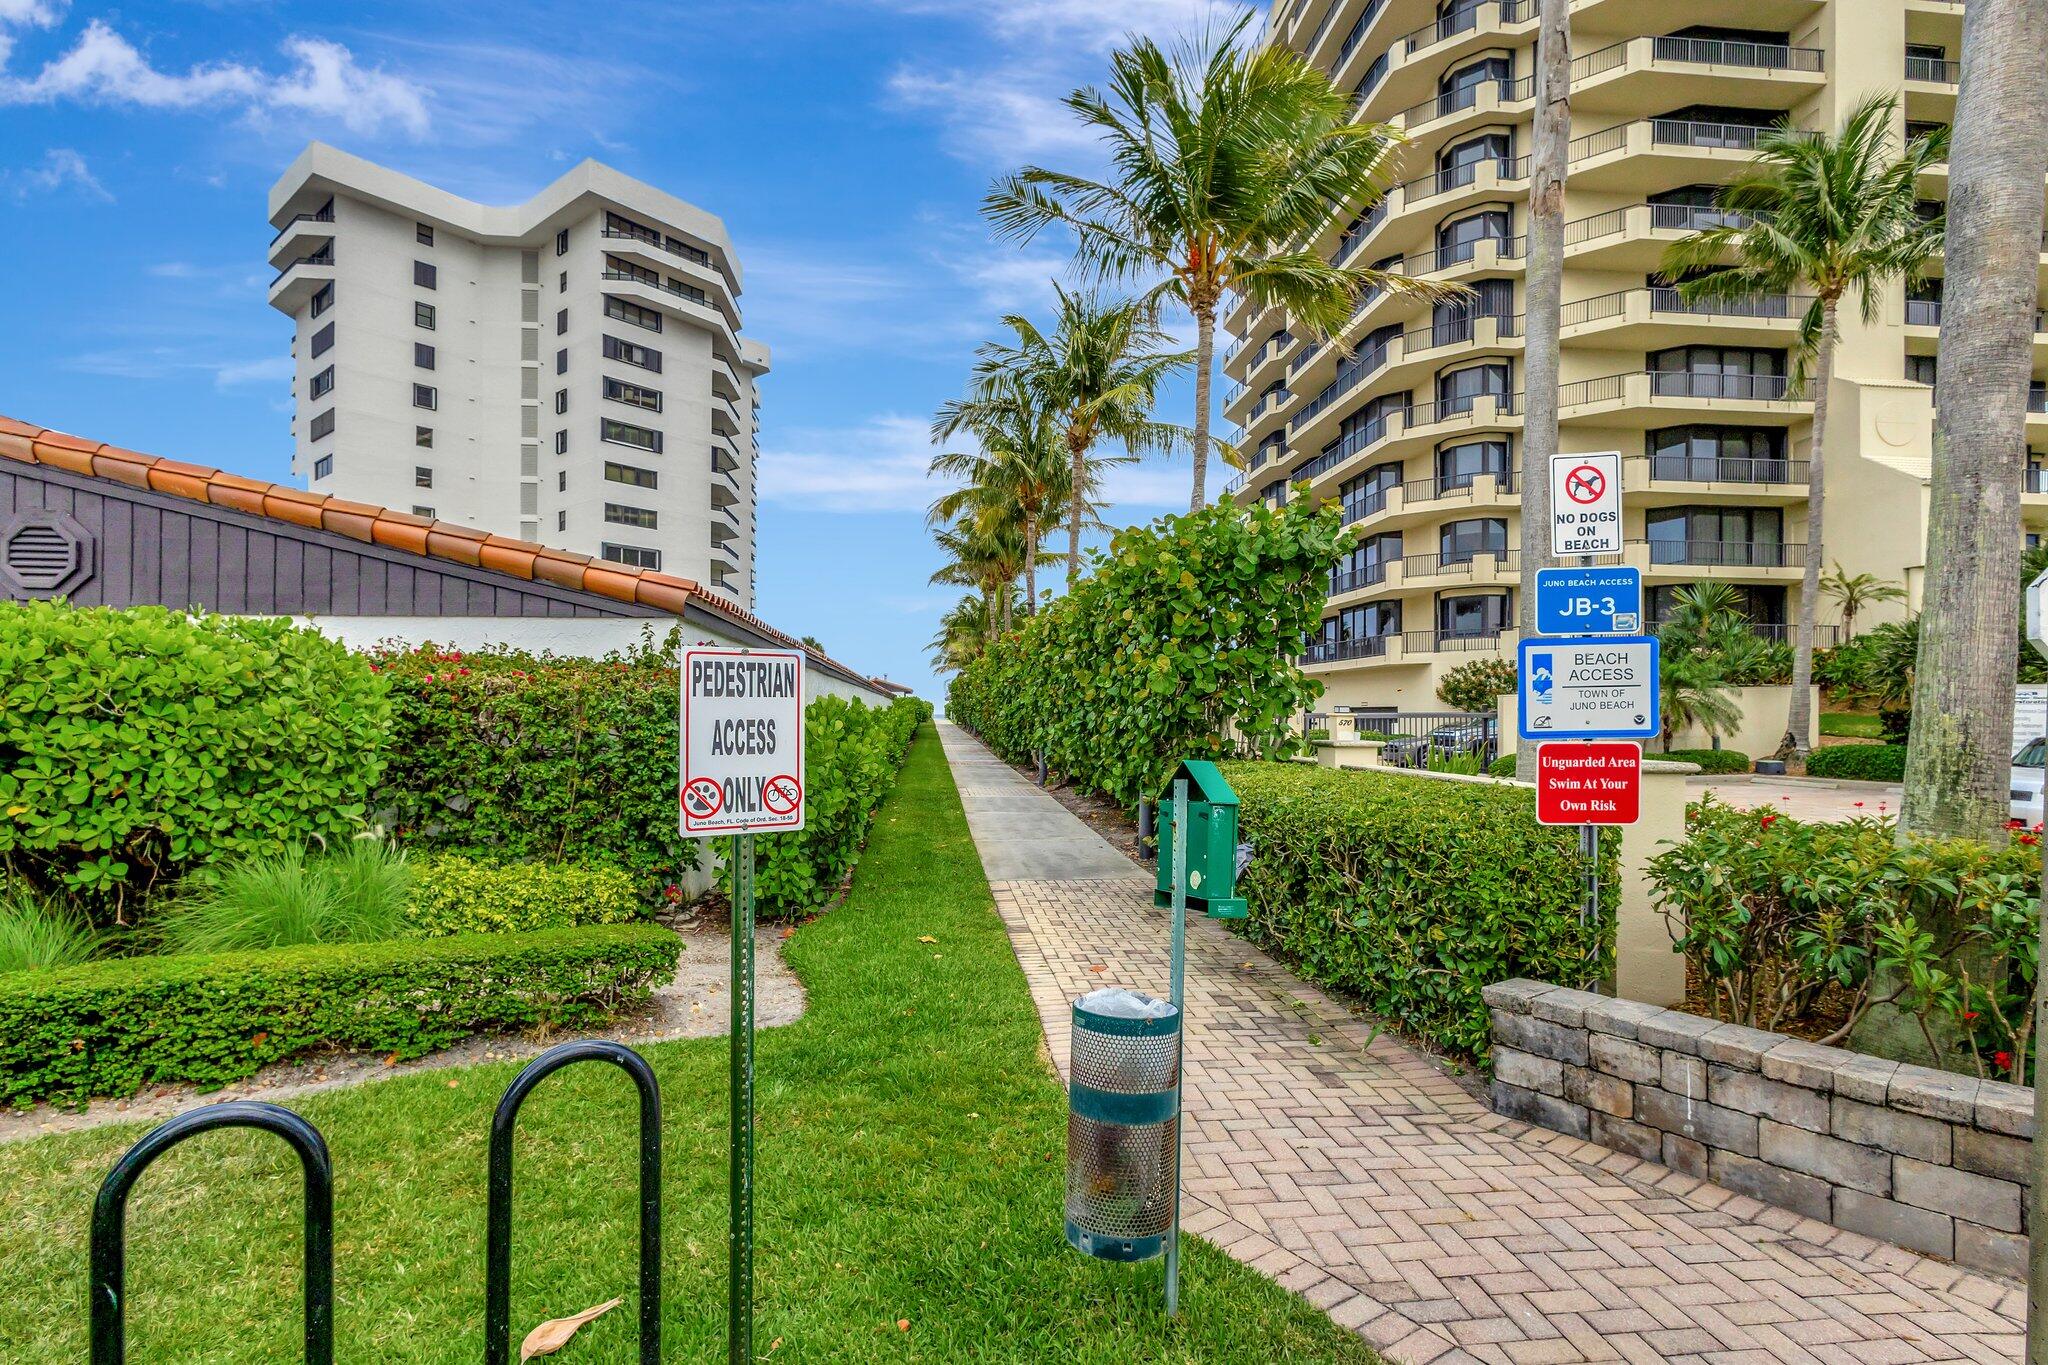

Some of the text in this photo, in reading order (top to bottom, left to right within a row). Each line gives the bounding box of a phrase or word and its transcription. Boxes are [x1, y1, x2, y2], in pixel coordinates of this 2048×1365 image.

[1556, 511, 1617, 525] NO DOGS
[1577, 526, 1596, 536] ON
[1565, 538, 1609, 550] BEACH
[1568, 579, 1597, 587] BEACH
[1599, 578, 1633, 586] ACCESS
[1559, 597, 1616, 616] JB-3
[1574, 652, 1628, 666] BEACH
[692, 661, 795, 698] PEDESTRIAN
[1569, 668, 1634, 682] ACCESS
[1578, 689, 1625, 699] TOWN OF
[1570, 701, 1635, 711] JUNO BEACH
[711, 719, 776, 756] ACCESS
[1542, 756, 1636, 770] Unguarded Area
[1549, 778, 1628, 790] Swim At Your
[723, 776, 766, 814] ONLY
[1560, 799, 1617, 811] Own Risk
